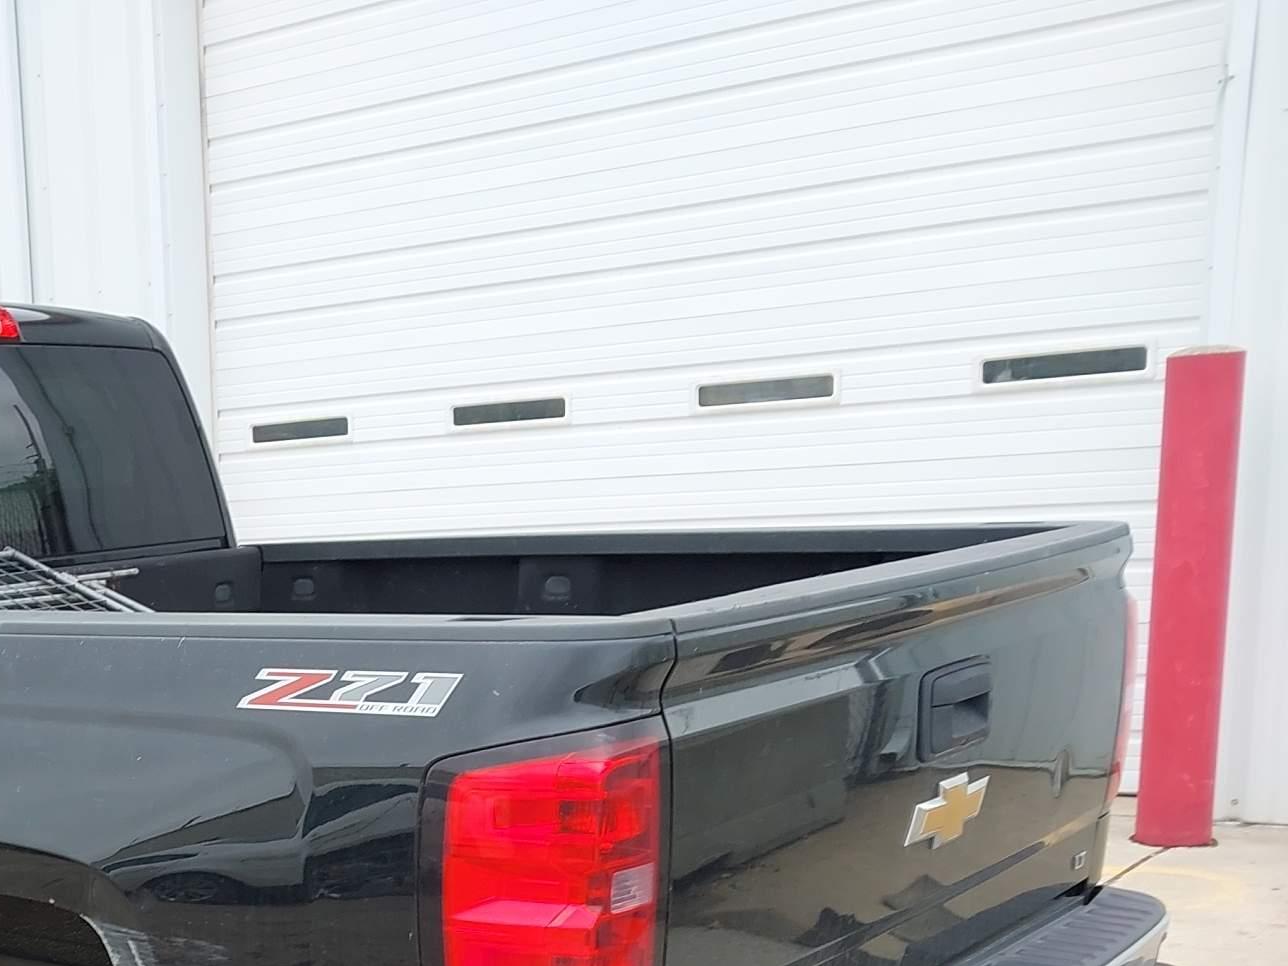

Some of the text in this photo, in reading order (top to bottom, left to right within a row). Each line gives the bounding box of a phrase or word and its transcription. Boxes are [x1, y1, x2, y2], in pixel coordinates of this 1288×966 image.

[236, 667, 464, 711] Z71
[358, 703, 439, 715] OFF ROAD
